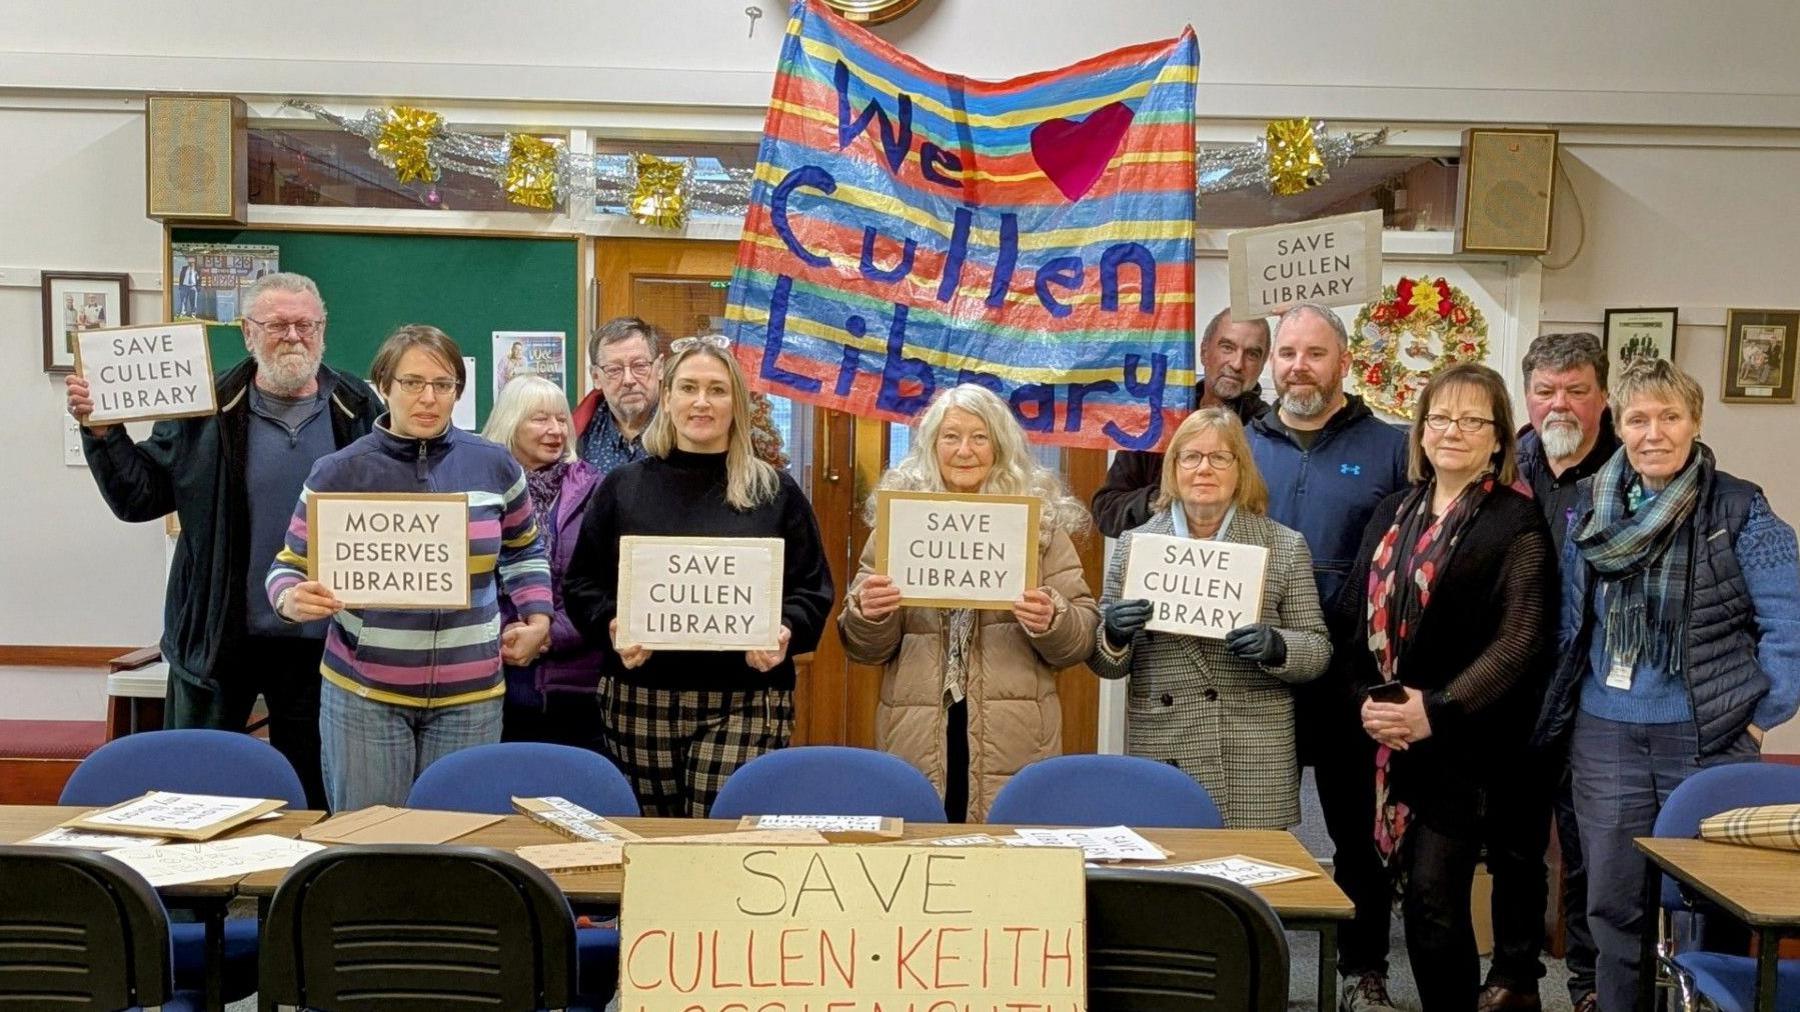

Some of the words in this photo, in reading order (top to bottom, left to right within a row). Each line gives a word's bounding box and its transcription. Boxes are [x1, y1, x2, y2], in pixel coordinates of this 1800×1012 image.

[834, 59, 964, 187] We
[771, 164, 1156, 317] Cullen
[1278, 232, 1335, 256] SAVE
[1263, 255, 1350, 281] CULLEN
[1263, 277, 1353, 305] LIBRARY
[113, 334, 173, 356] SAVE
[100, 360, 192, 384] CULLEN
[101, 385, 197, 411] LIBRARY
[345, 512, 440, 533] MORAY
[927, 512, 990, 533] SAVE
[336, 542, 449, 563] DESERVES
[909, 539, 1005, 561] CULLEN
[1164, 545, 1230, 570] SAVE
[668, 554, 735, 576] SAVE
[333, 570, 453, 592] LIBRARIES
[907, 567, 1008, 589] LIBRARY
[1144, 571, 1242, 601] CULLEN
[650, 583, 752, 605] CULLEN
[647, 613, 755, 634] LIBRARY
[736, 850, 972, 917] SAVE
